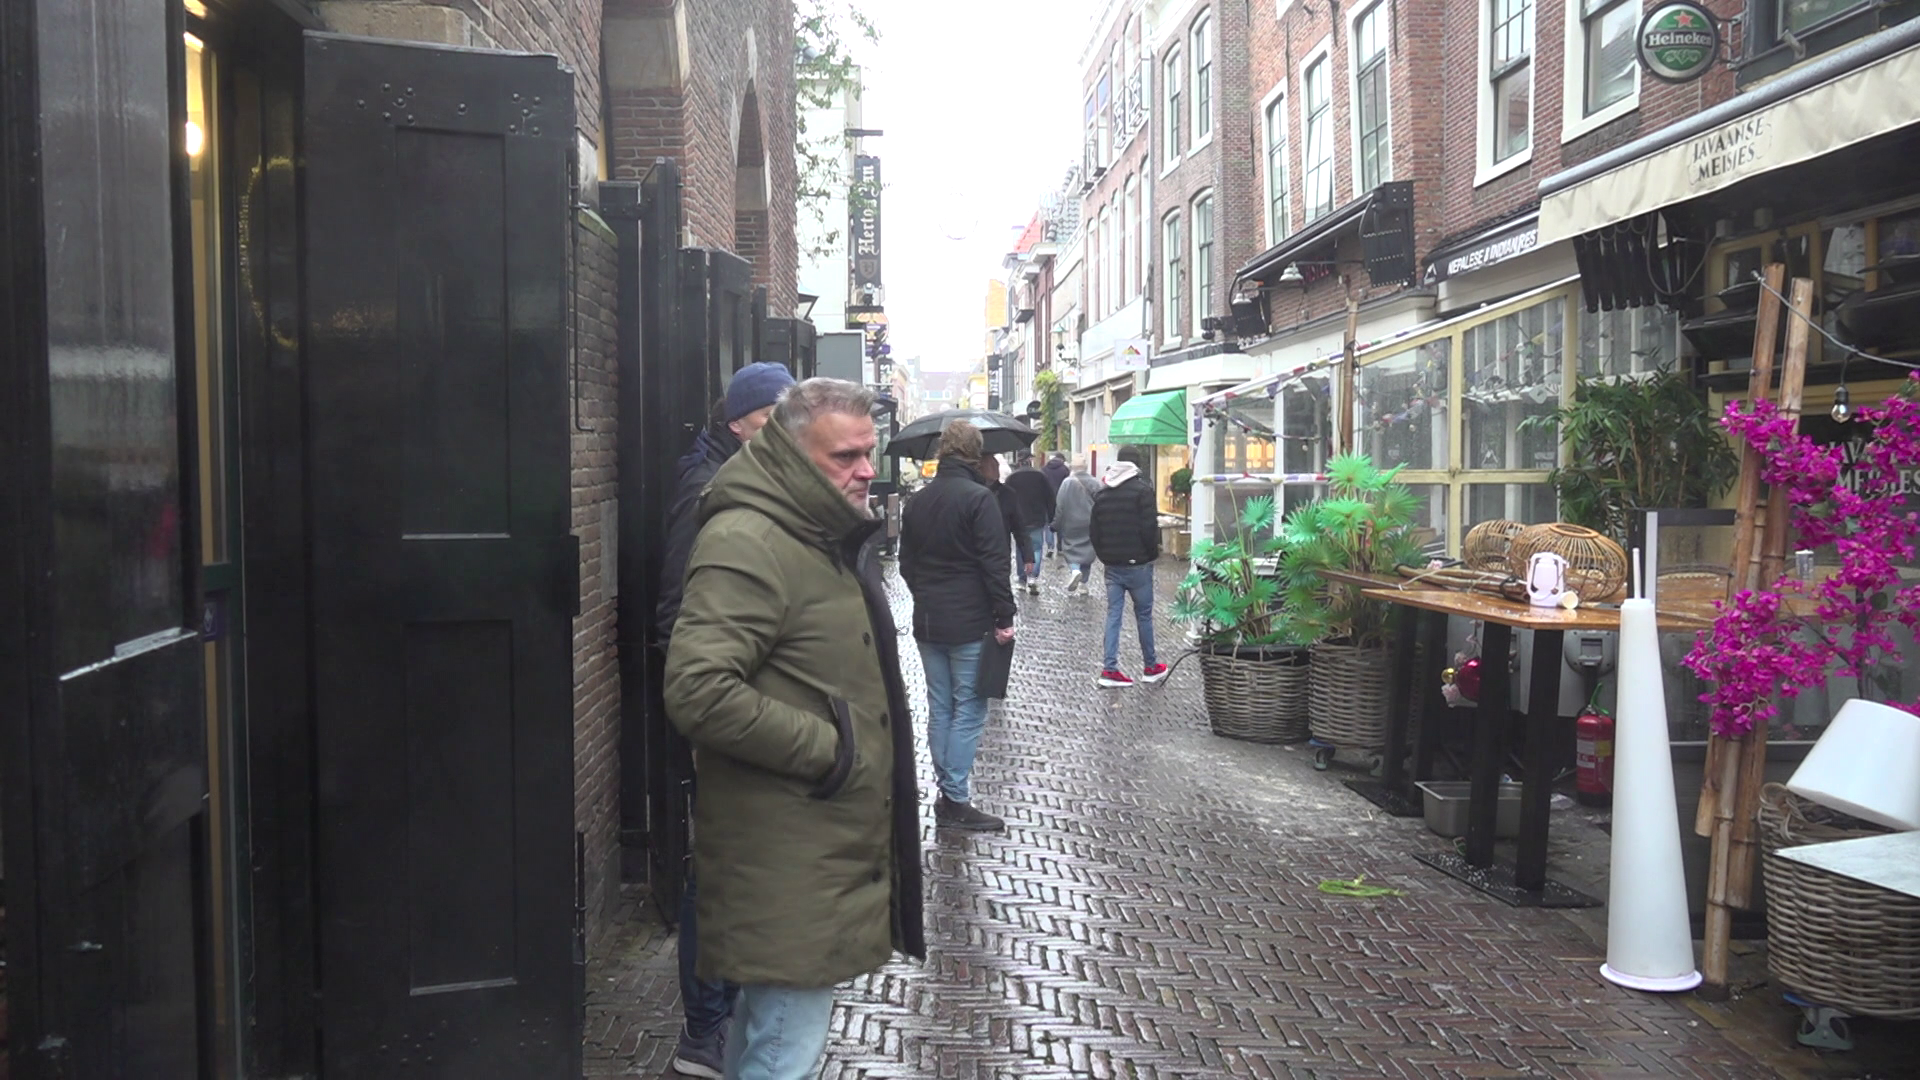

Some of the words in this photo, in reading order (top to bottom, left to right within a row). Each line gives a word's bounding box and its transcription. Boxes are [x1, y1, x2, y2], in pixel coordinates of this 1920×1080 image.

[1648, 32, 1712, 46] Heineken
[1692, 116, 1765, 163] JAVAANSE
[1698, 142, 1755, 181] MEISJES
[1448, 249, 1484, 275] NEPALESE
[1490, 237, 1518, 258] INDIAN
[1516, 229, 1538, 250] RES
